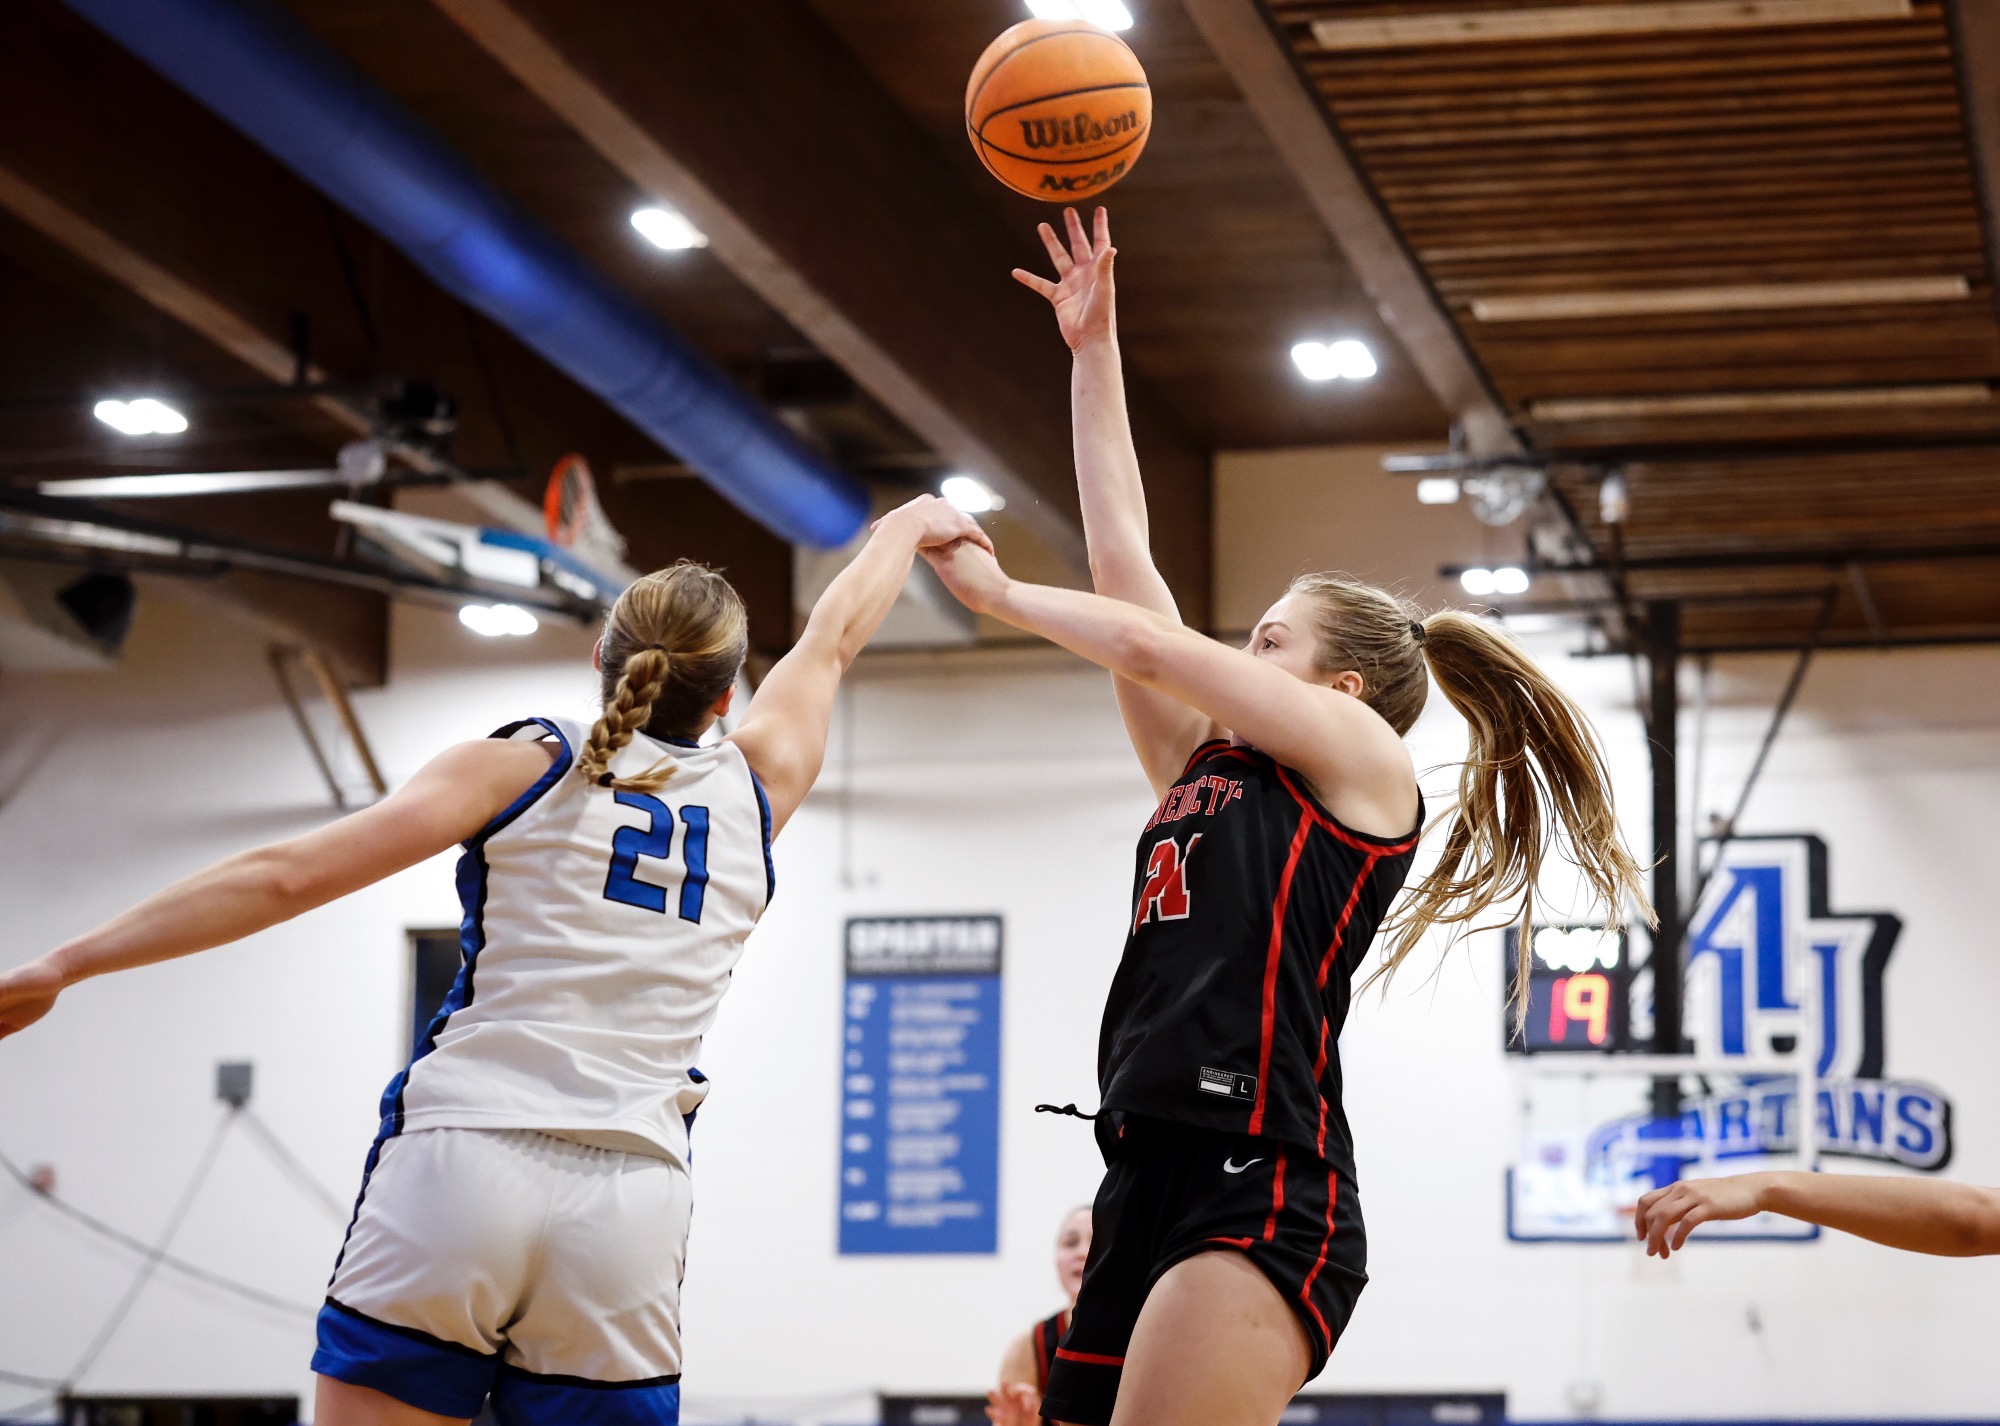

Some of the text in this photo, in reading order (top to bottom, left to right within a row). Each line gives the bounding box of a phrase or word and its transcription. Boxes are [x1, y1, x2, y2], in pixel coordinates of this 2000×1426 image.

[1020, 110, 1137, 148] Wilson
[1039, 161, 1126, 190] NCAA
[603, 790, 710, 925] 21
[1549, 974, 1611, 1045] 19
[1240, 1081, 1248, 1093] L
